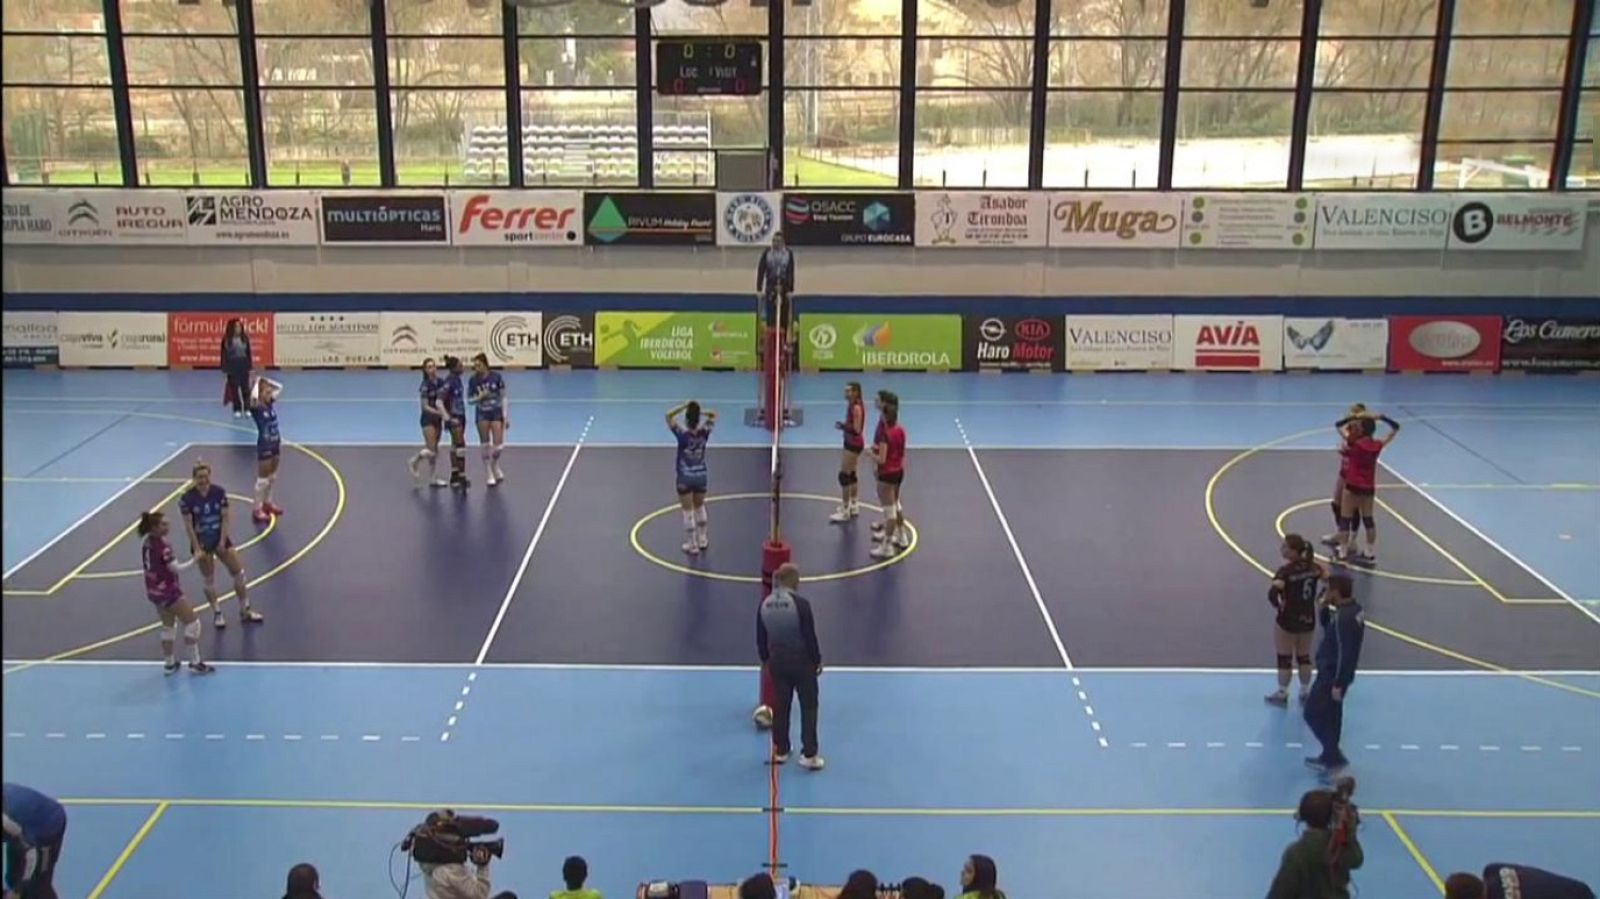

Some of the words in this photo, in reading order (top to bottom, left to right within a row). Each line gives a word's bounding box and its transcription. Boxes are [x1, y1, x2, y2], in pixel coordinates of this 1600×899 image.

[220, 196, 264, 207] AGRO
[115, 206, 166, 215] AUTO
[220, 207, 313, 220] MENDOZA
[459, 195, 576, 233] Ferrer
[1321, 205, 1447, 226] VALENCISO
[1054, 200, 1177, 239] Muga
[671, 325, 694, 337] LIGA
[1069, 328, 1172, 344] VALENCISO
[506, 333, 539, 346] ETH
[560, 333, 593, 347] ETH
[977, 341, 1010, 359] Haro
[1012, 341, 1054, 360] Motor
[862, 351, 950, 366] IBERDROLA
